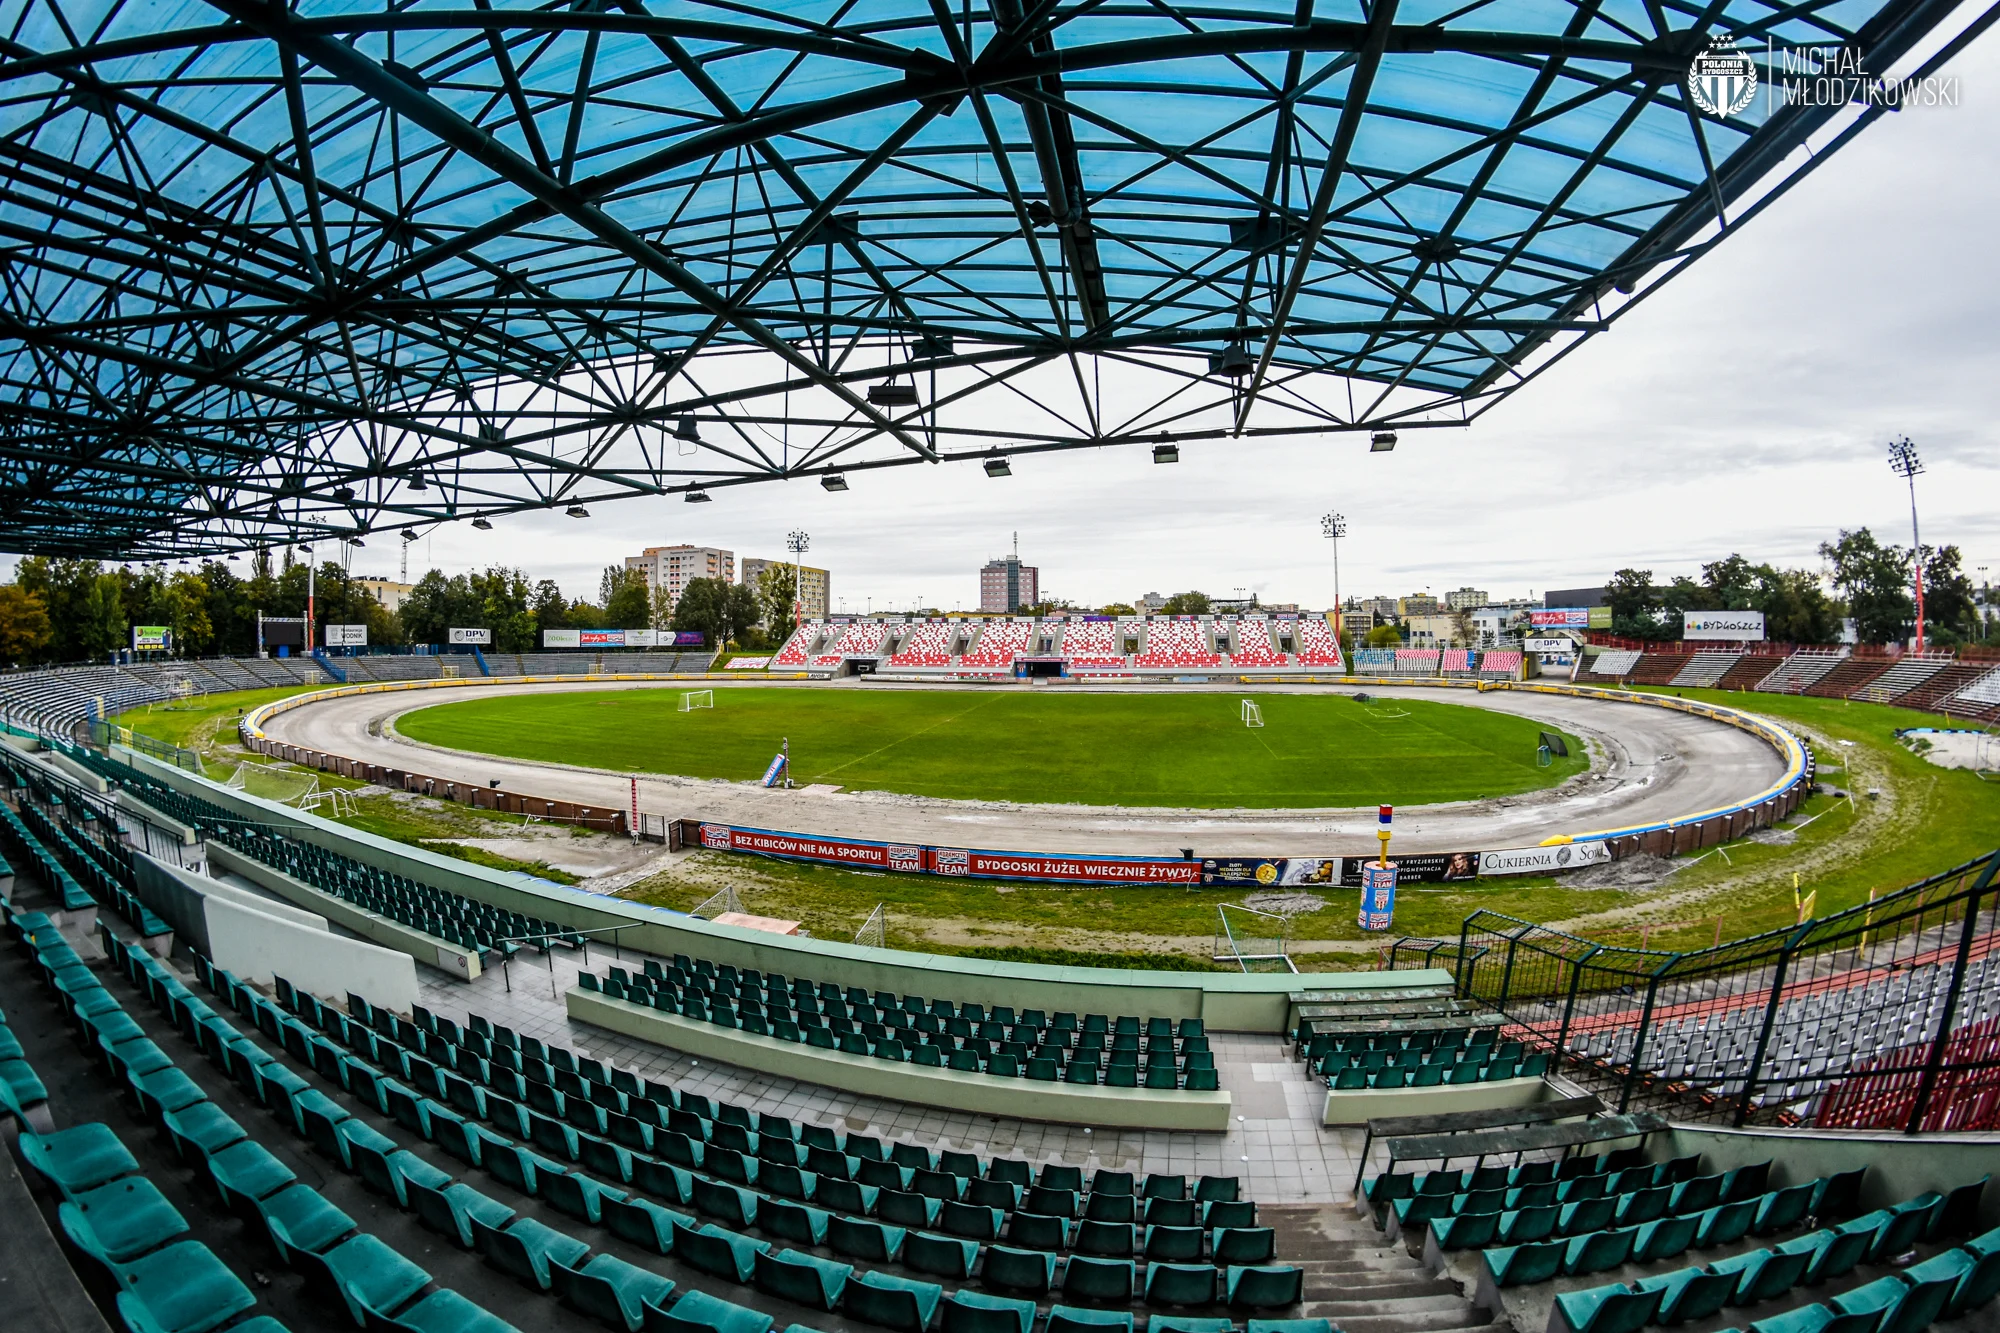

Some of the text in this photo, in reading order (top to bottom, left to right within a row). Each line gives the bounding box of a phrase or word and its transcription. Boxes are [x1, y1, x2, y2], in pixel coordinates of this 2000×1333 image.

[1703, 621, 1762, 630] BYDGOSZCZ
[707, 838, 731, 849] TEAM
[735, 835, 882, 861] BEZ KIBICÓW NIE MA SPORTU!
[890, 860, 919, 871] TEAM
[1485, 853, 1552, 869] CUKIERNIA
[939, 864, 968, 875] TEAM
[977, 860, 1041, 872] BYDGOSKI
[1043, 861, 1082, 874] ŻUŻEL
[1084, 865, 1146, 877] WIECZNIE
[1149, 865, 1192, 878] ŻYWY!
[1370, 921, 1388, 929] TEAM
